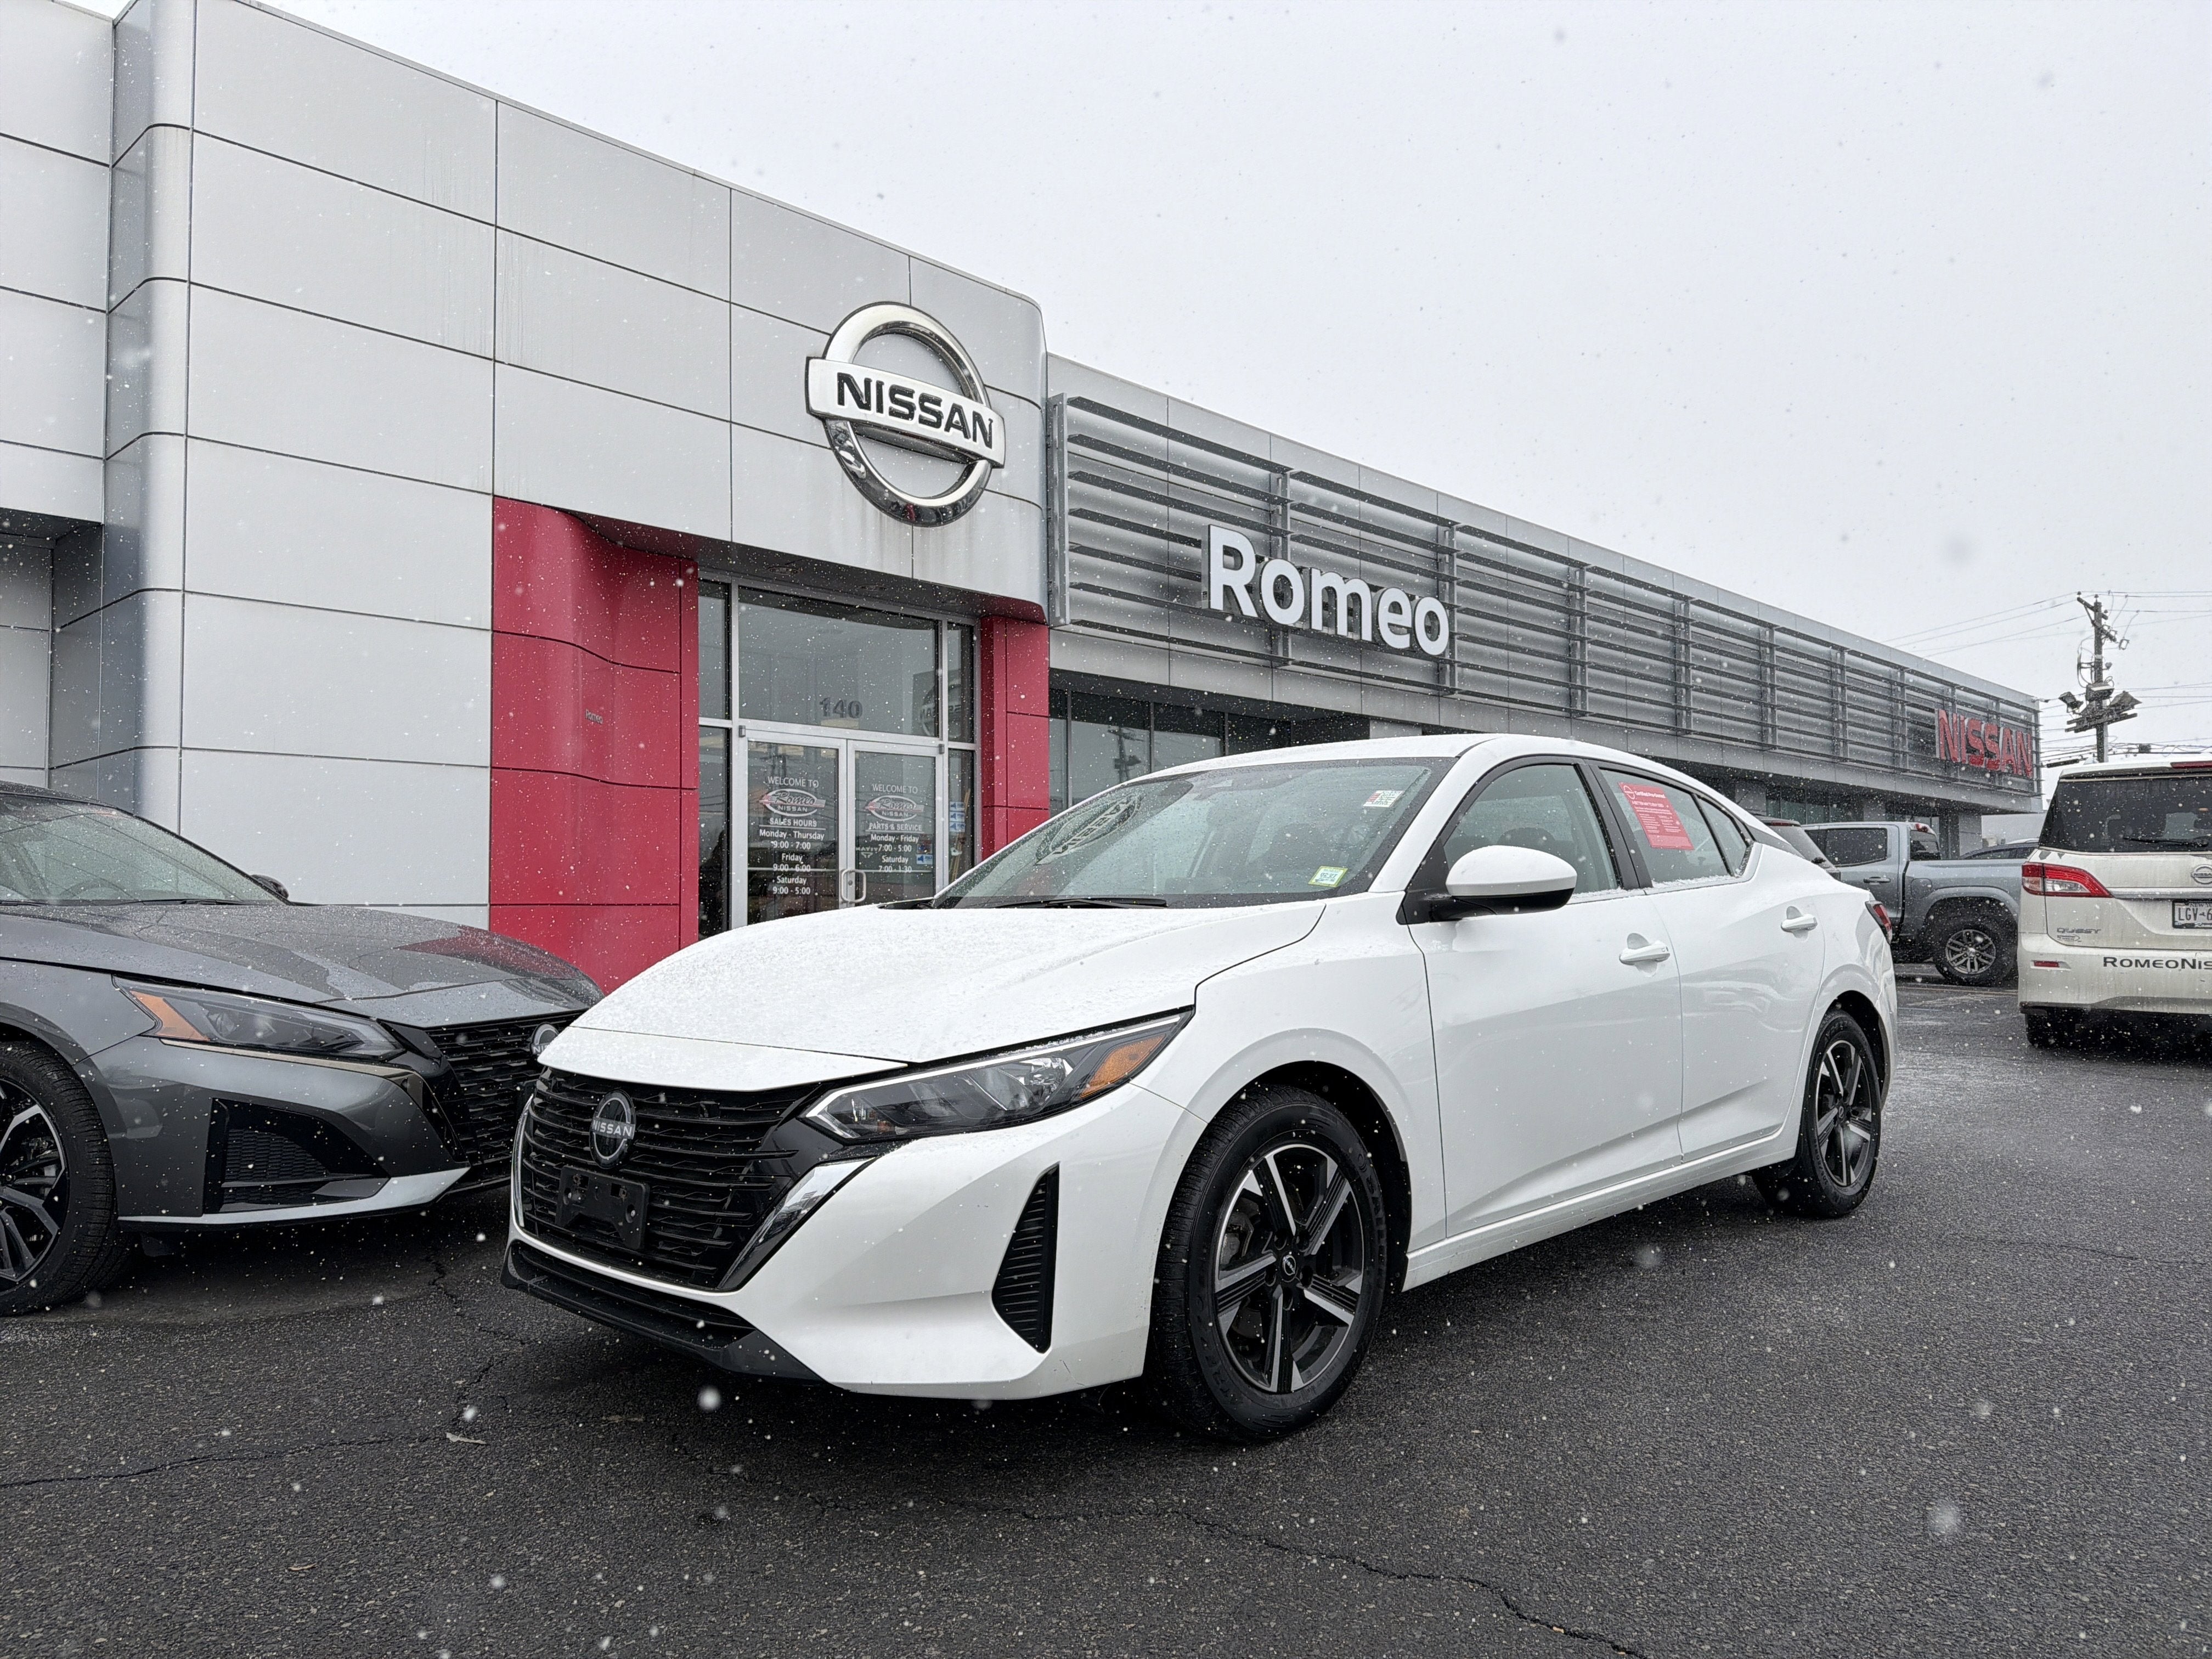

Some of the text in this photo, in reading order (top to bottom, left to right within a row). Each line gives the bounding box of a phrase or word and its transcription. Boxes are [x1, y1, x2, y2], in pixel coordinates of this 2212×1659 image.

[837, 371, 994, 449] NISSAN
[1208, 523, 1449, 656] Romeo
[819, 697, 864, 719] 140
[585, 708, 603, 725] Romeo
[1937, 708, 2033, 779] NISSAN
[768, 776, 819, 788] WELCOME TO
[872, 783, 918, 794] WELCOME TO
[771, 790, 815, 805] Romeo
[769, 817, 817, 827] SALES HOURS
[868, 822, 889, 831] PARTS
[759, 829, 787, 839] Monday
[793, 830, 825, 840] Thursday
[871, 833, 895, 843] Monday
[900, 834, 919, 844] Friday
[795, 842, 811, 850] 7:00
[878, 844, 893, 852] 7:00
[782, 853, 803, 862] Friday
[882, 855, 909, 865] Saturday
[773, 864, 789, 872] 9:00
[795, 864, 811, 872] 6:00
[777, 876, 807, 885] Saturday
[795, 887, 811, 895] 5:00
[592, 1120, 633, 1137] NISSAN
